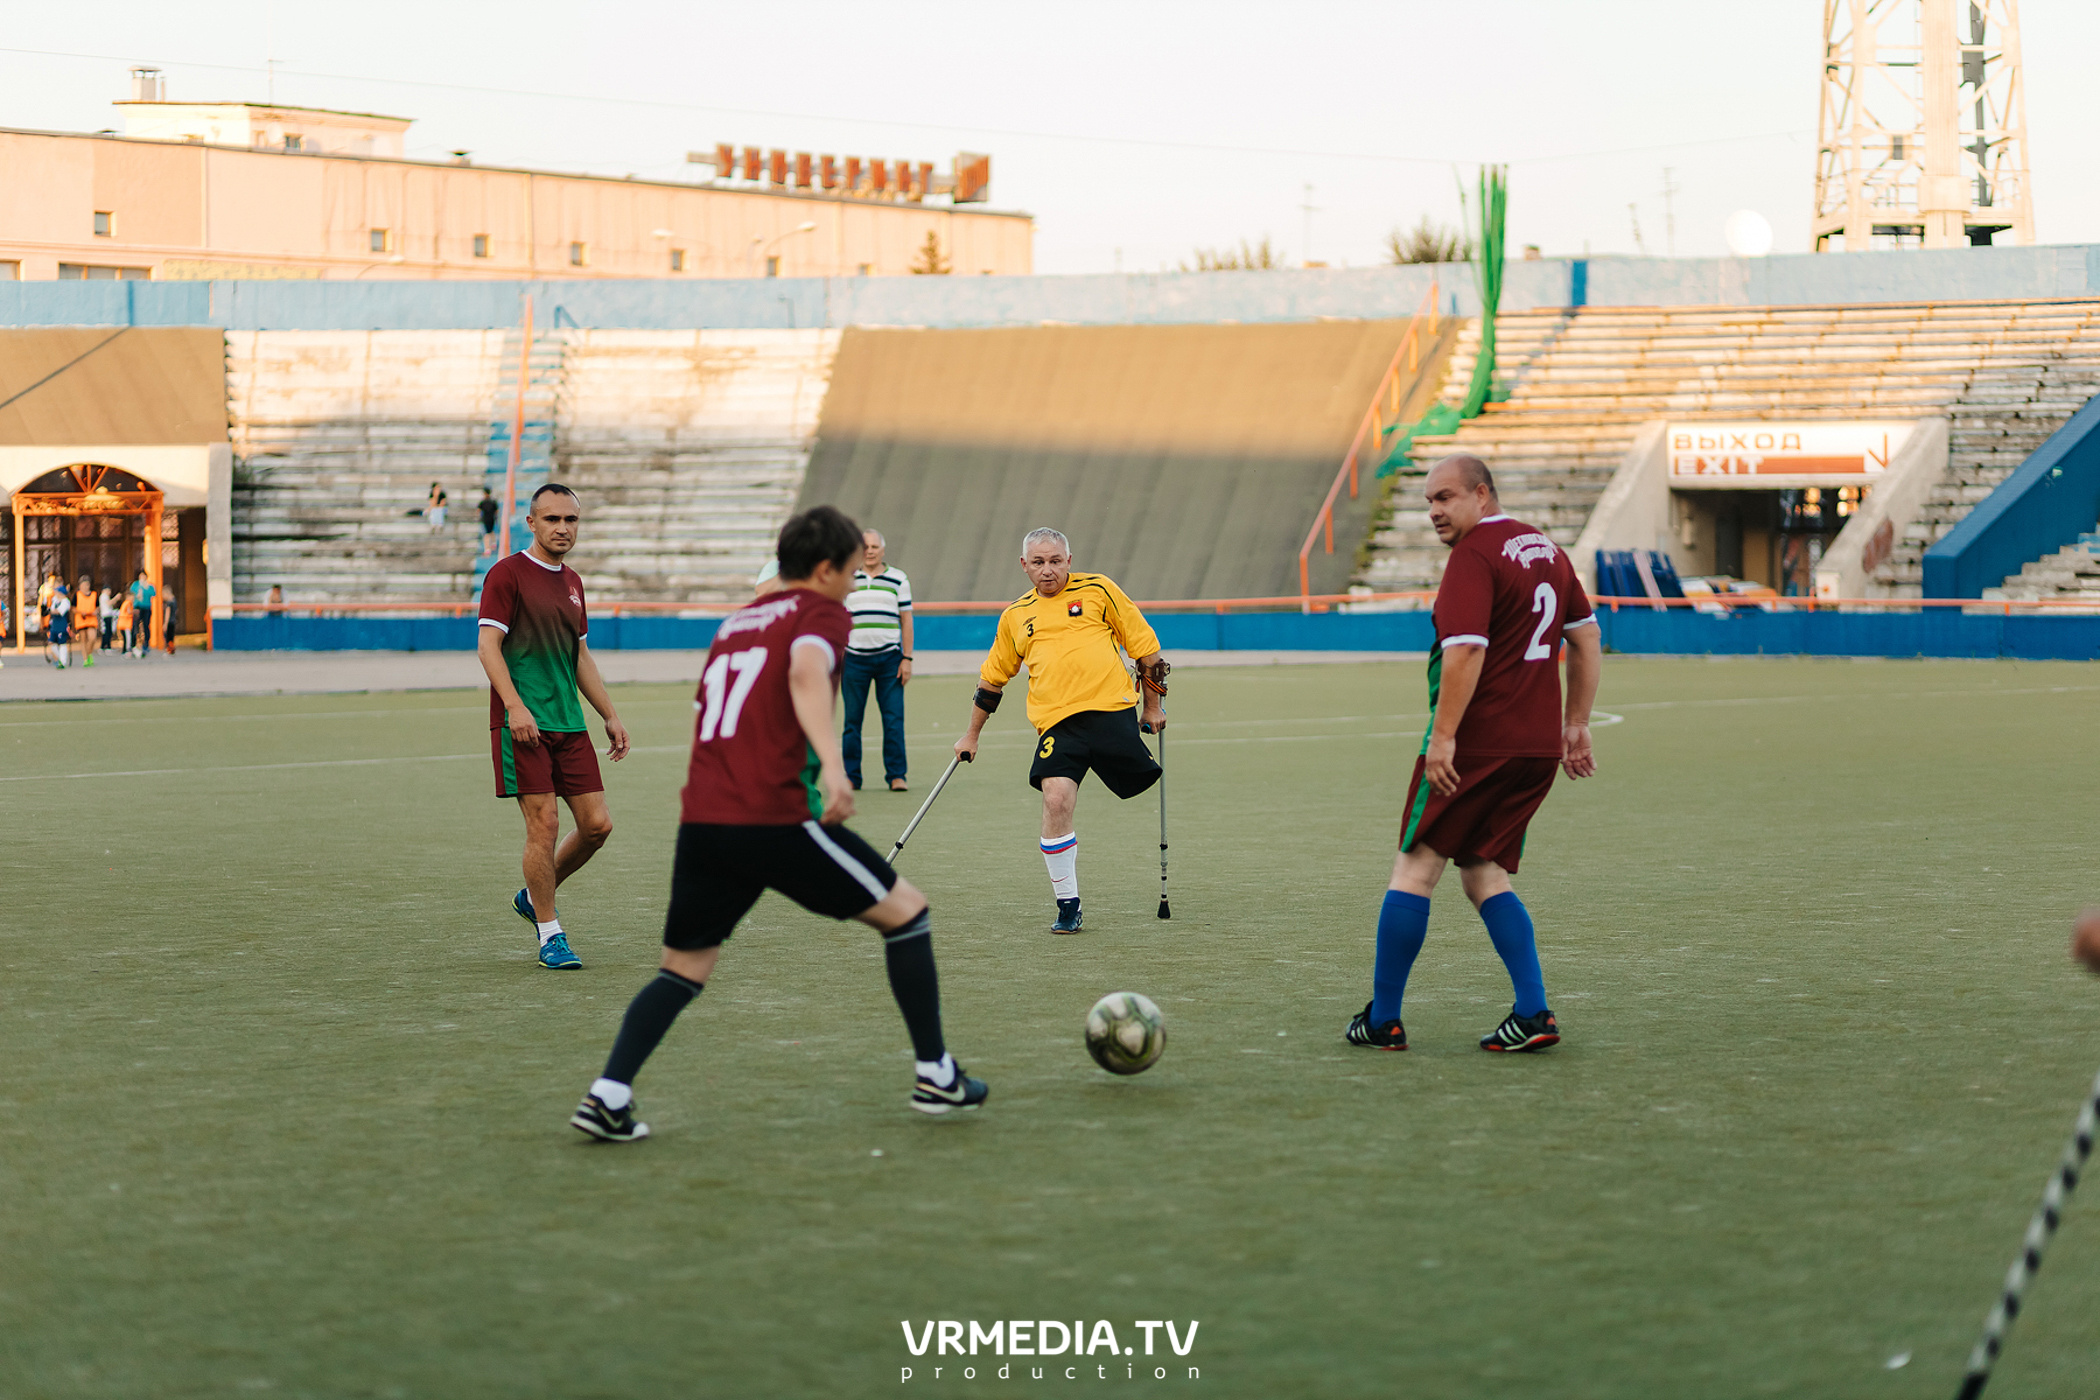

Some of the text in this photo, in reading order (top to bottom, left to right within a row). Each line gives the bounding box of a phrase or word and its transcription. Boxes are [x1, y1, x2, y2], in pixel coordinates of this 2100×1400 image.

[1674, 432, 1801, 450] ВЫХОД
[1677, 454, 1764, 475] EXIT
[1026, 623, 1034, 638] 3
[1523, 581, 1558, 661] 2
[699, 646, 768, 742] 17
[1039, 736, 1056, 759] 3
